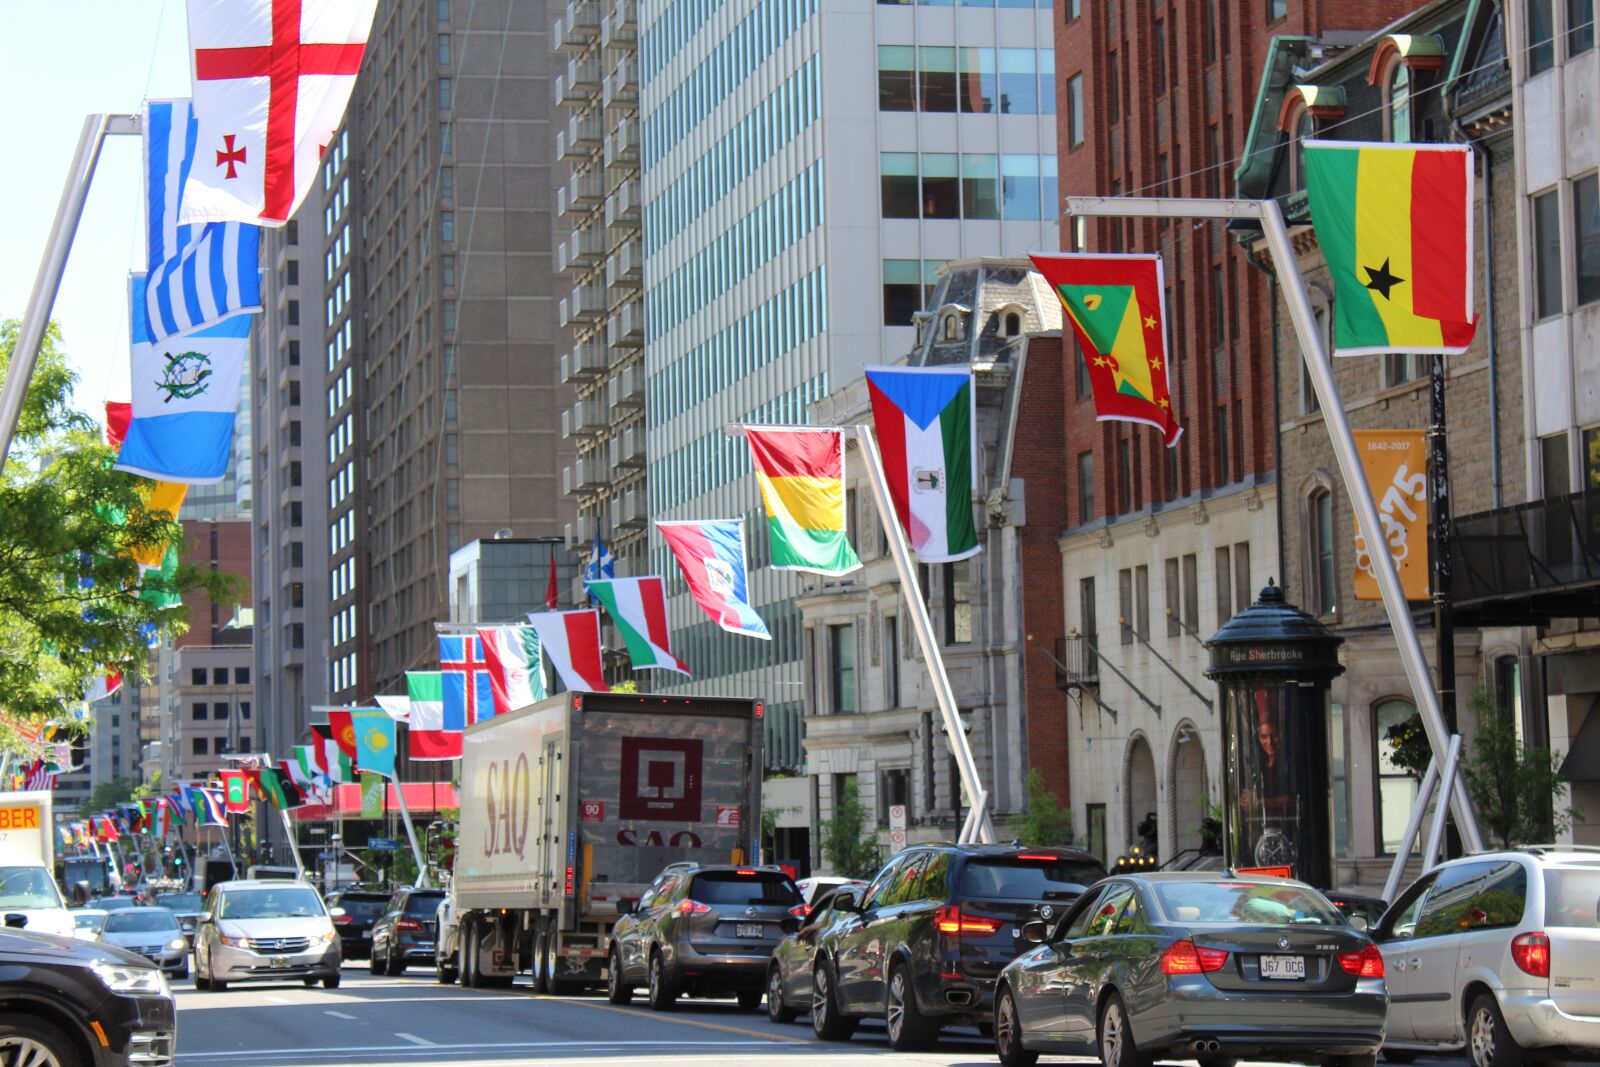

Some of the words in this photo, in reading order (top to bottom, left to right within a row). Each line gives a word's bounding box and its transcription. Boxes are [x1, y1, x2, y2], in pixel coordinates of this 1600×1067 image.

[1367, 442, 1410, 451] 1642-2017
[1230, 650, 1247, 661] Rue
[1248, 649, 1304, 661] Sherbrooke
[484, 751, 530, 862] SAQ
[585, 804, 599, 815] 90
[1262, 960, 1280, 973] J67
[1285, 961, 1304, 973] DCG
